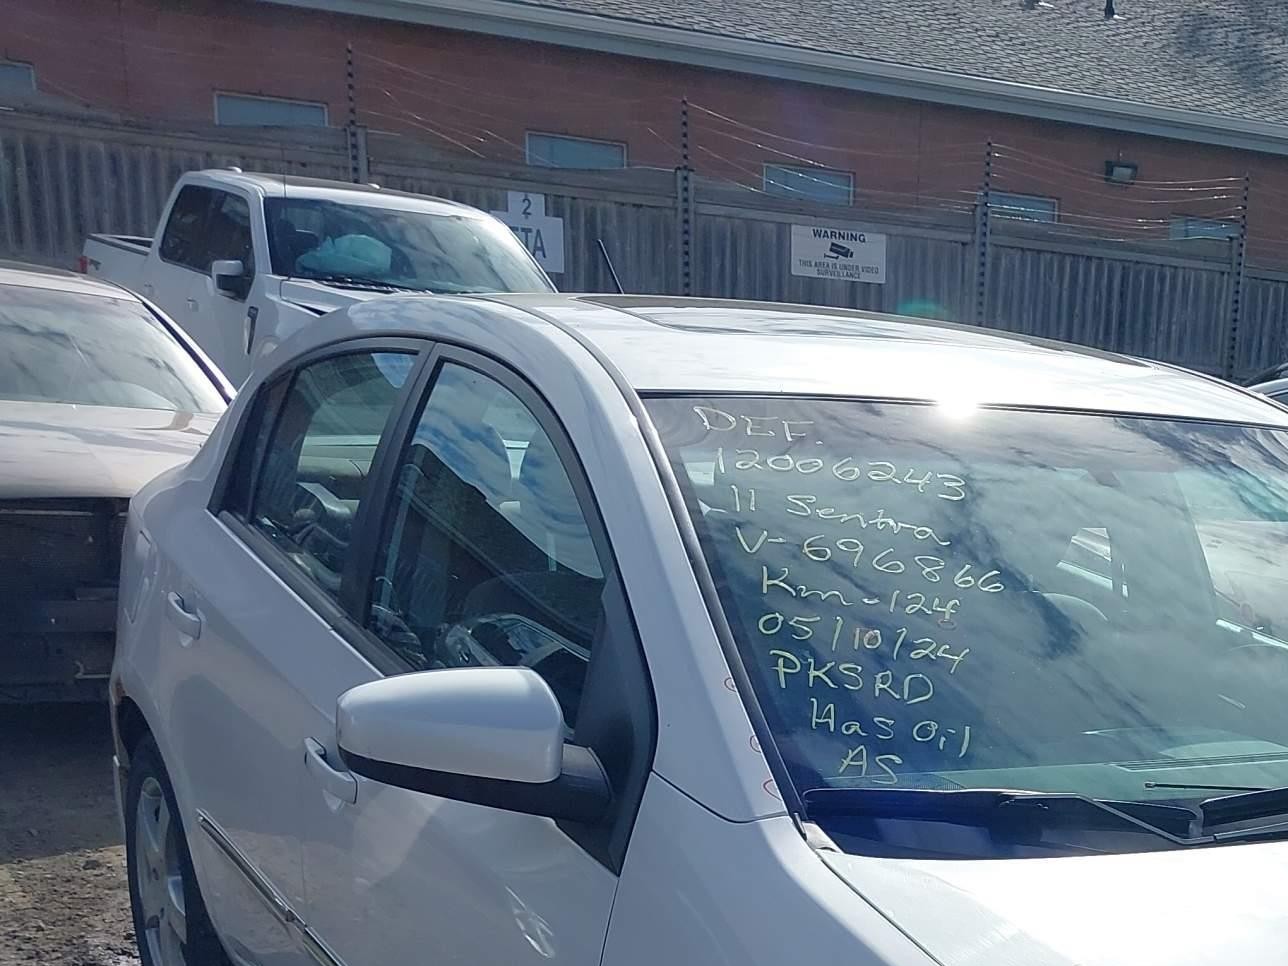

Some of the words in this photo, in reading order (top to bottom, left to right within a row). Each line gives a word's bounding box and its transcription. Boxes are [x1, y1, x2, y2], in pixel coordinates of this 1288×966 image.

[521, 198, 532, 216] 2
[812, 229, 866, 243] WARNING
[799, 259, 812, 268] THIS
[814, 260, 830, 269] AREA
[831, 262, 838, 270] IS
[839, 263, 860, 273] UNDER
[861, 265, 879, 274] VIDEO
[816, 269, 860, 279] SURVEILLANCE
[717, 447, 967, 500] 12006243
[730, 485, 757, 512] 11
[786, 494, 952, 546] Sentra
[757, 611, 971, 674] 05/10/24
[810, 698, 896, 740] Has
[911, 719, 972, 759] Oil
